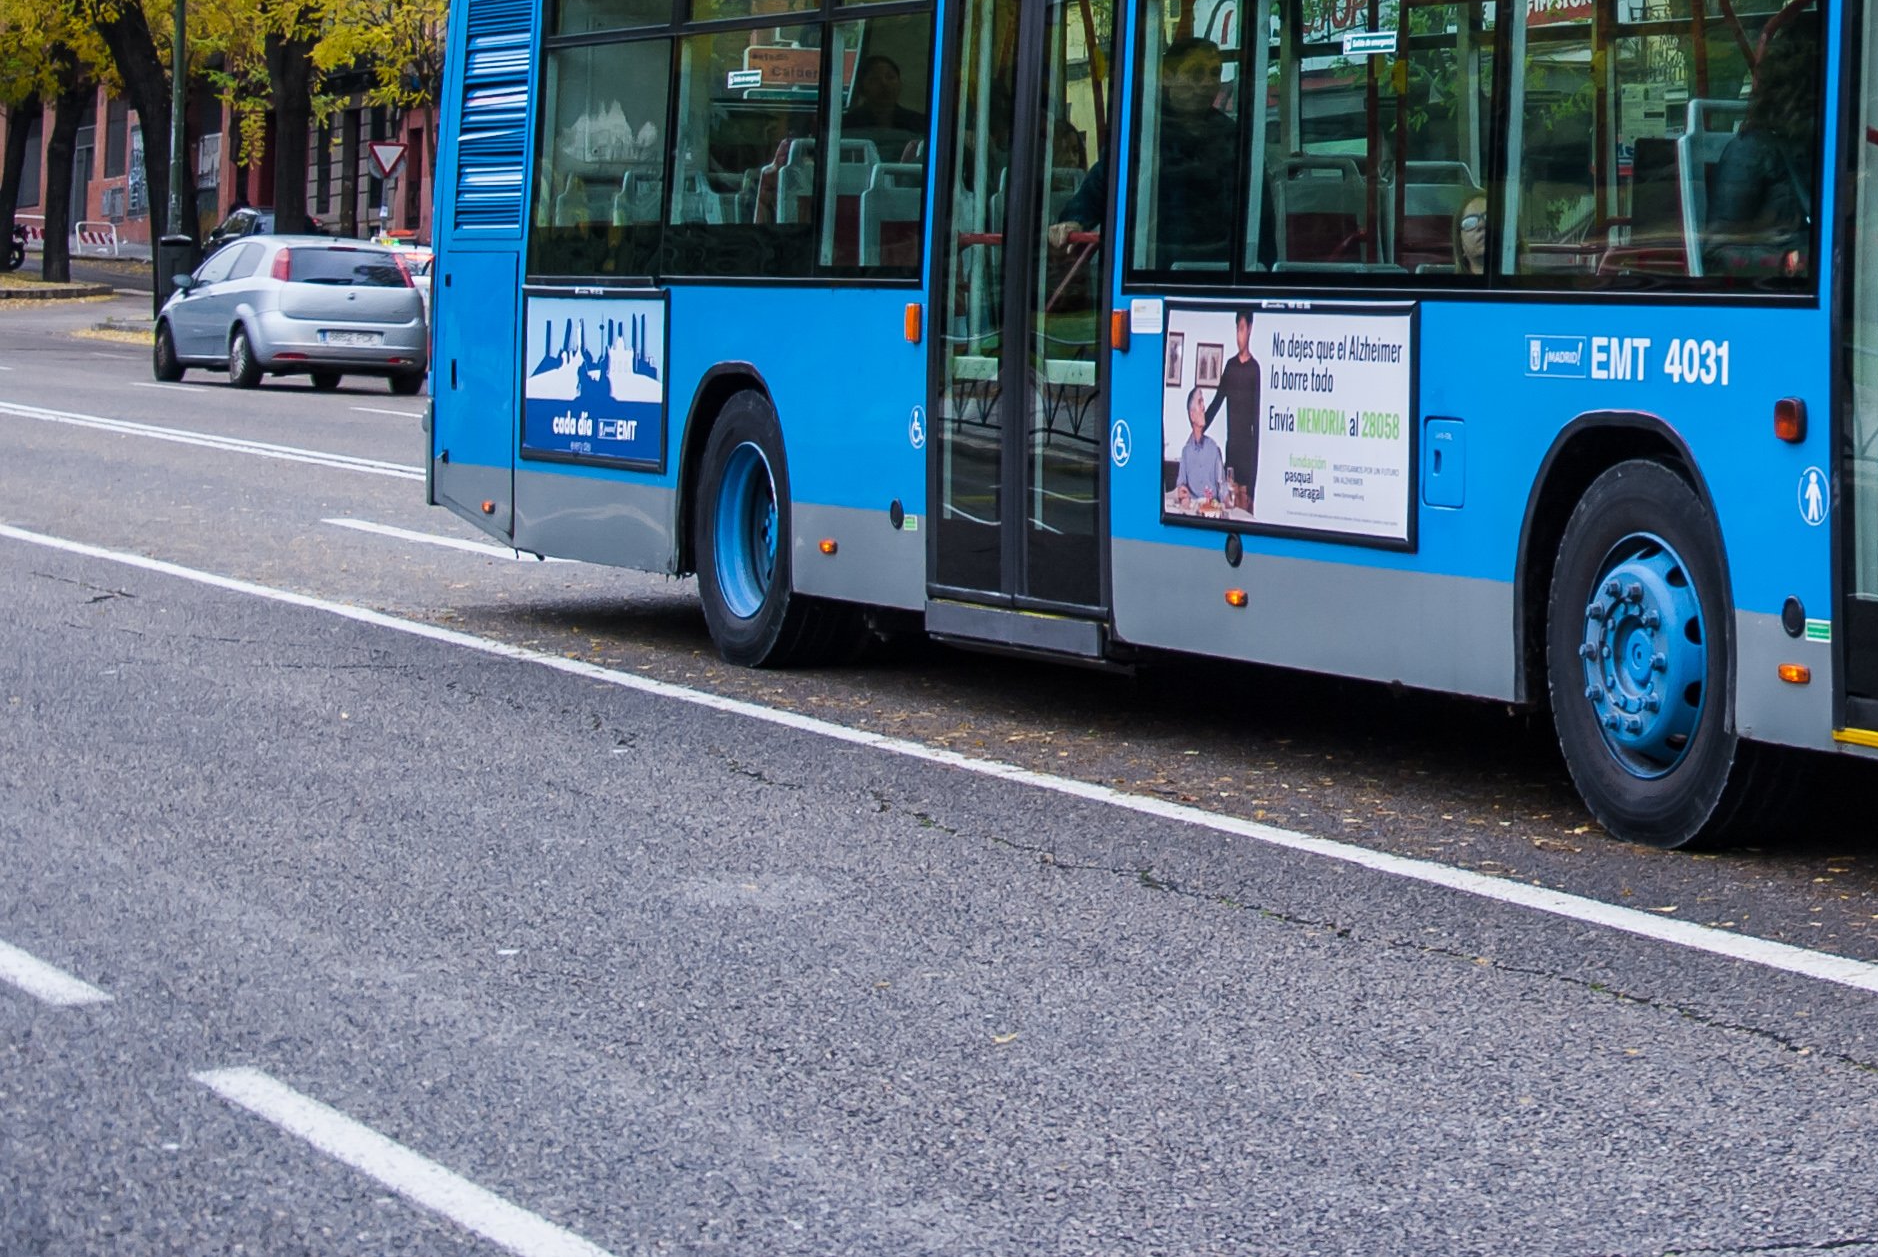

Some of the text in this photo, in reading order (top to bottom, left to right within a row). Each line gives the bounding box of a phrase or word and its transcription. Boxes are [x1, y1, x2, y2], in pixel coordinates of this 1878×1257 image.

[1272, 332, 1403, 365] No dejes que el Alzheimer
[1591, 336, 1729, 386] EMT 4031
[1270, 364, 1334, 393] lo borre todo
[553, 410, 576, 435] cada
[577, 411, 593, 436] día
[616, 419, 638, 441] EMT
[1269, 405, 1400, 440] Envía MEMORIA al 28058
[1289, 453, 1327, 470] fundación
[1284, 469, 1314, 486] pasqual
[1292, 485, 1325, 503] maragall
